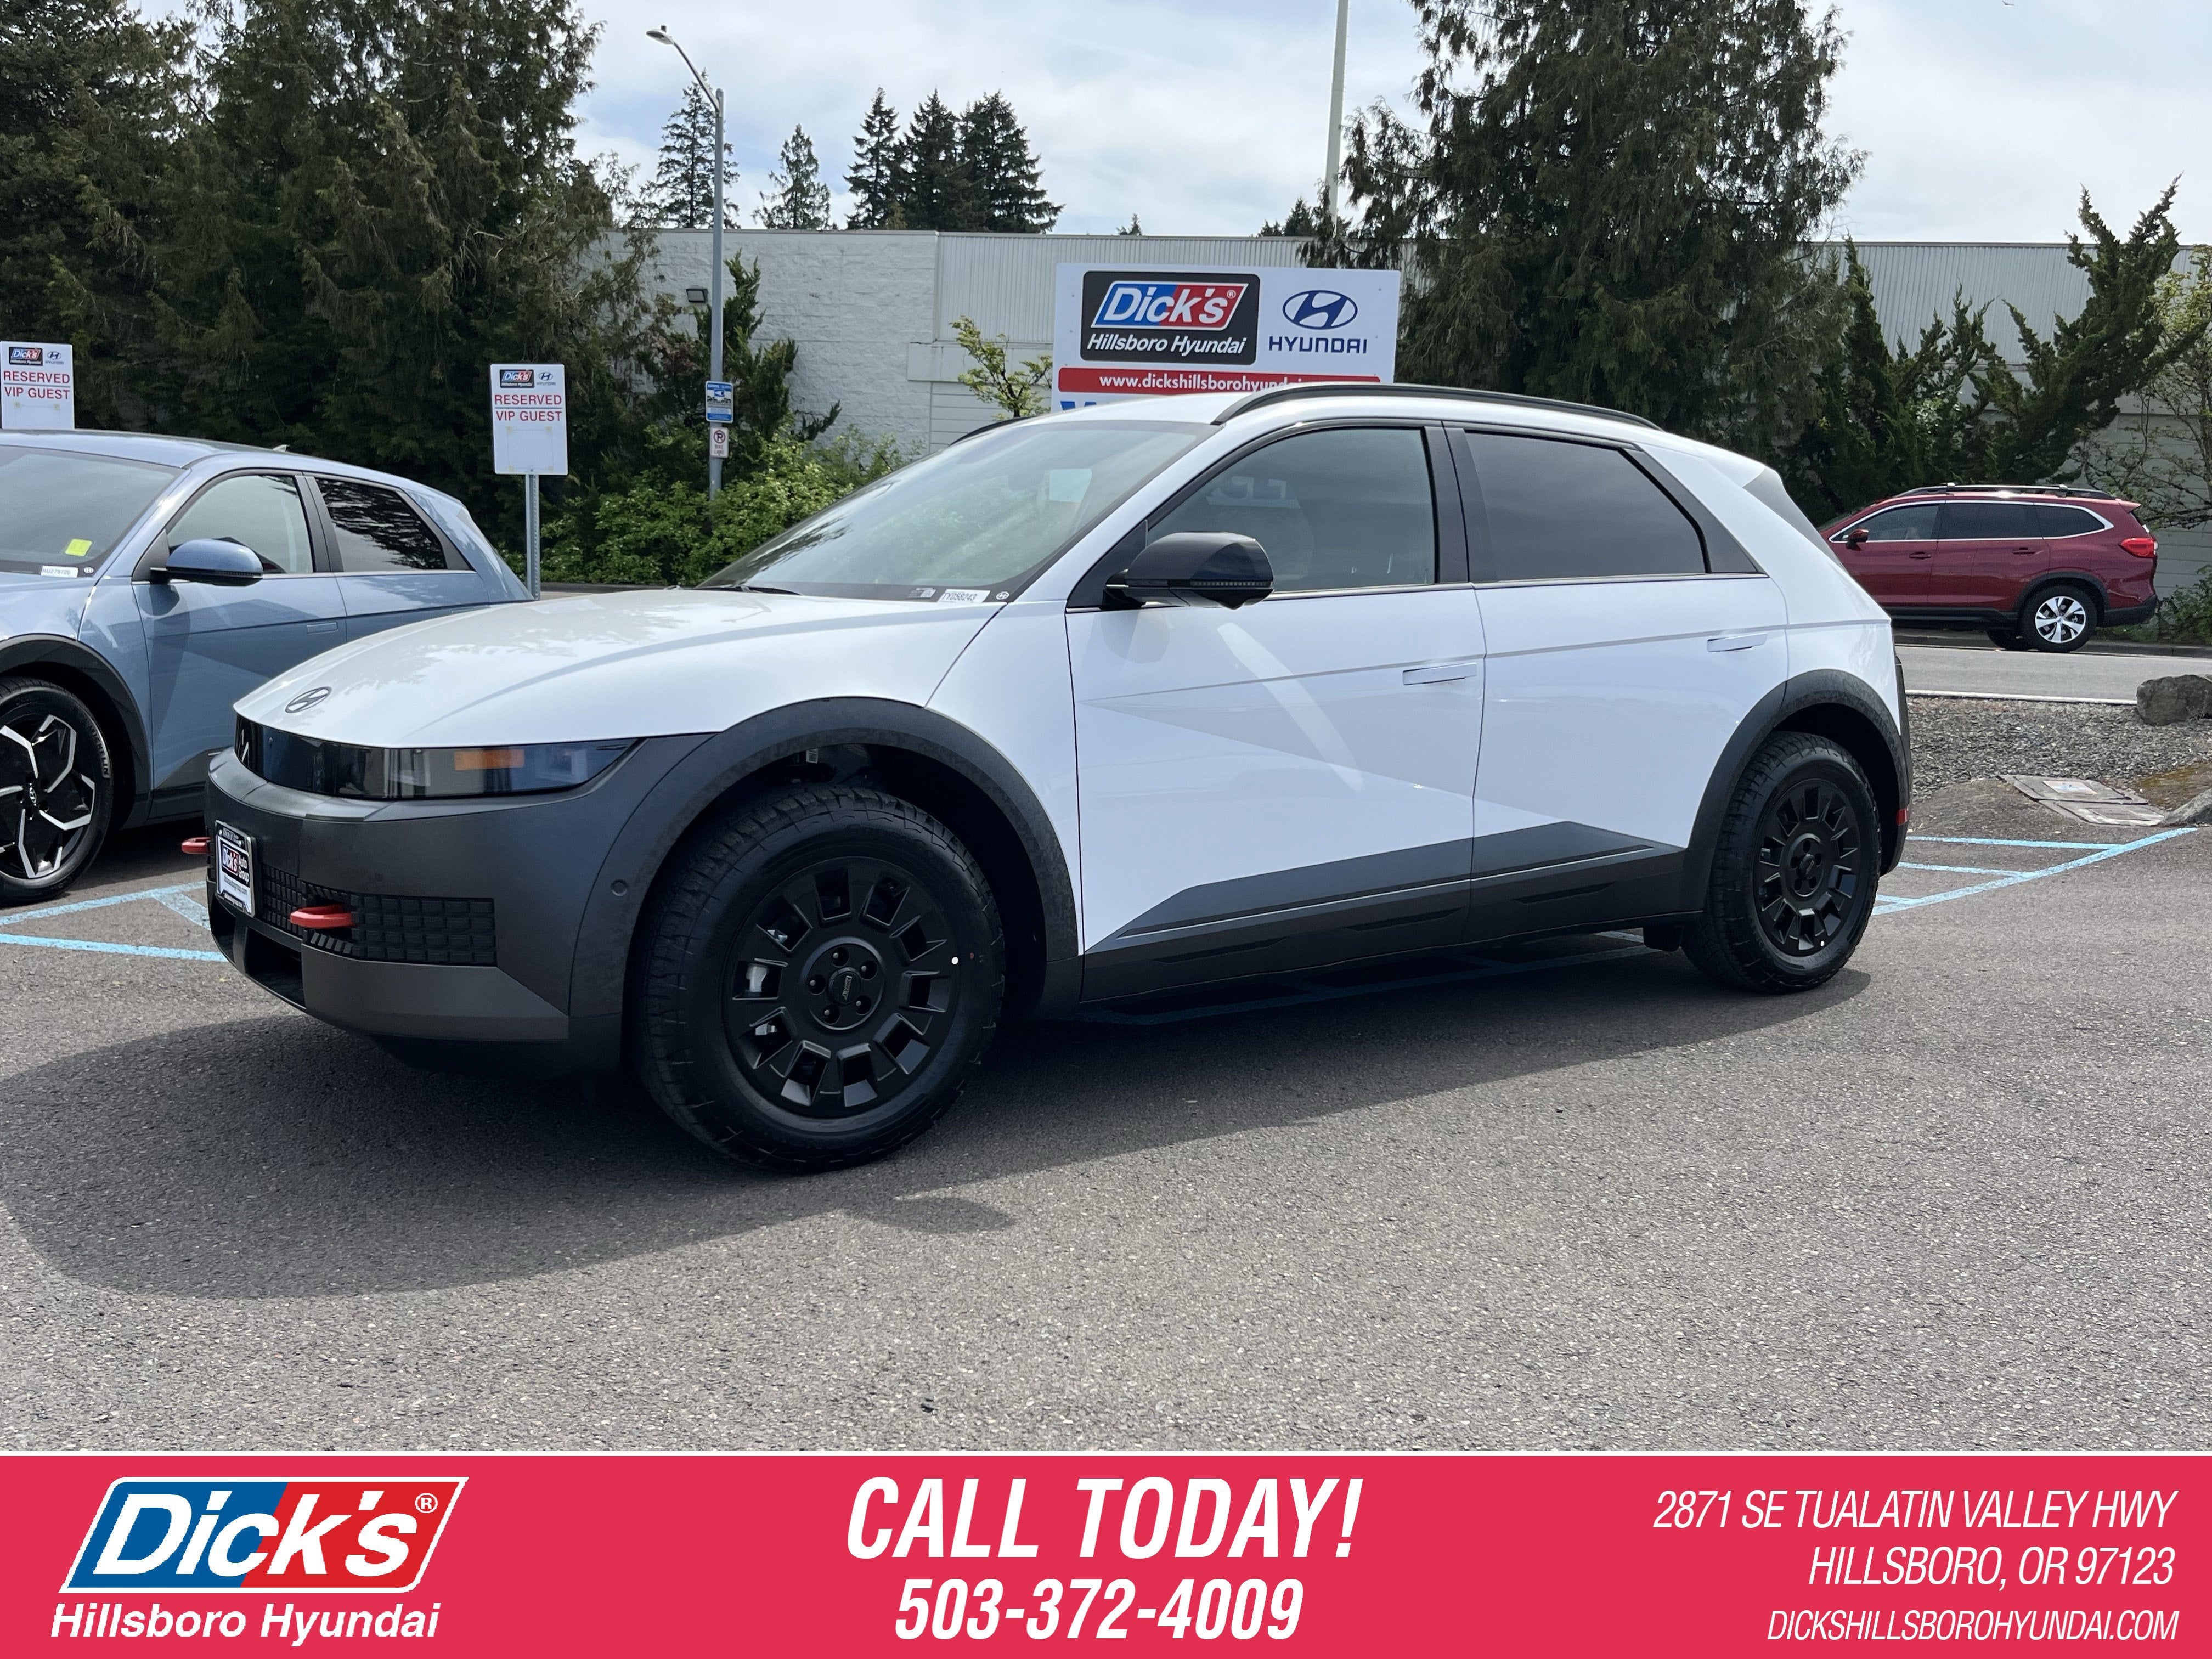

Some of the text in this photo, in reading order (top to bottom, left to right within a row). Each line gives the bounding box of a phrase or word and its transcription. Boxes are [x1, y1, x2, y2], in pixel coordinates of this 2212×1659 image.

[1103, 286, 1228, 323] Dick's
[1087, 333, 1247, 357] Hillsboro Hyundai
[1269, 336, 1367, 354] HYUNDAI
[3, 371, 70, 383] RESERVED
[4, 387, 70, 399] VIP GUEST
[495, 394, 562, 405] RESERVED
[496, 410, 562, 421] VIP GUEST
